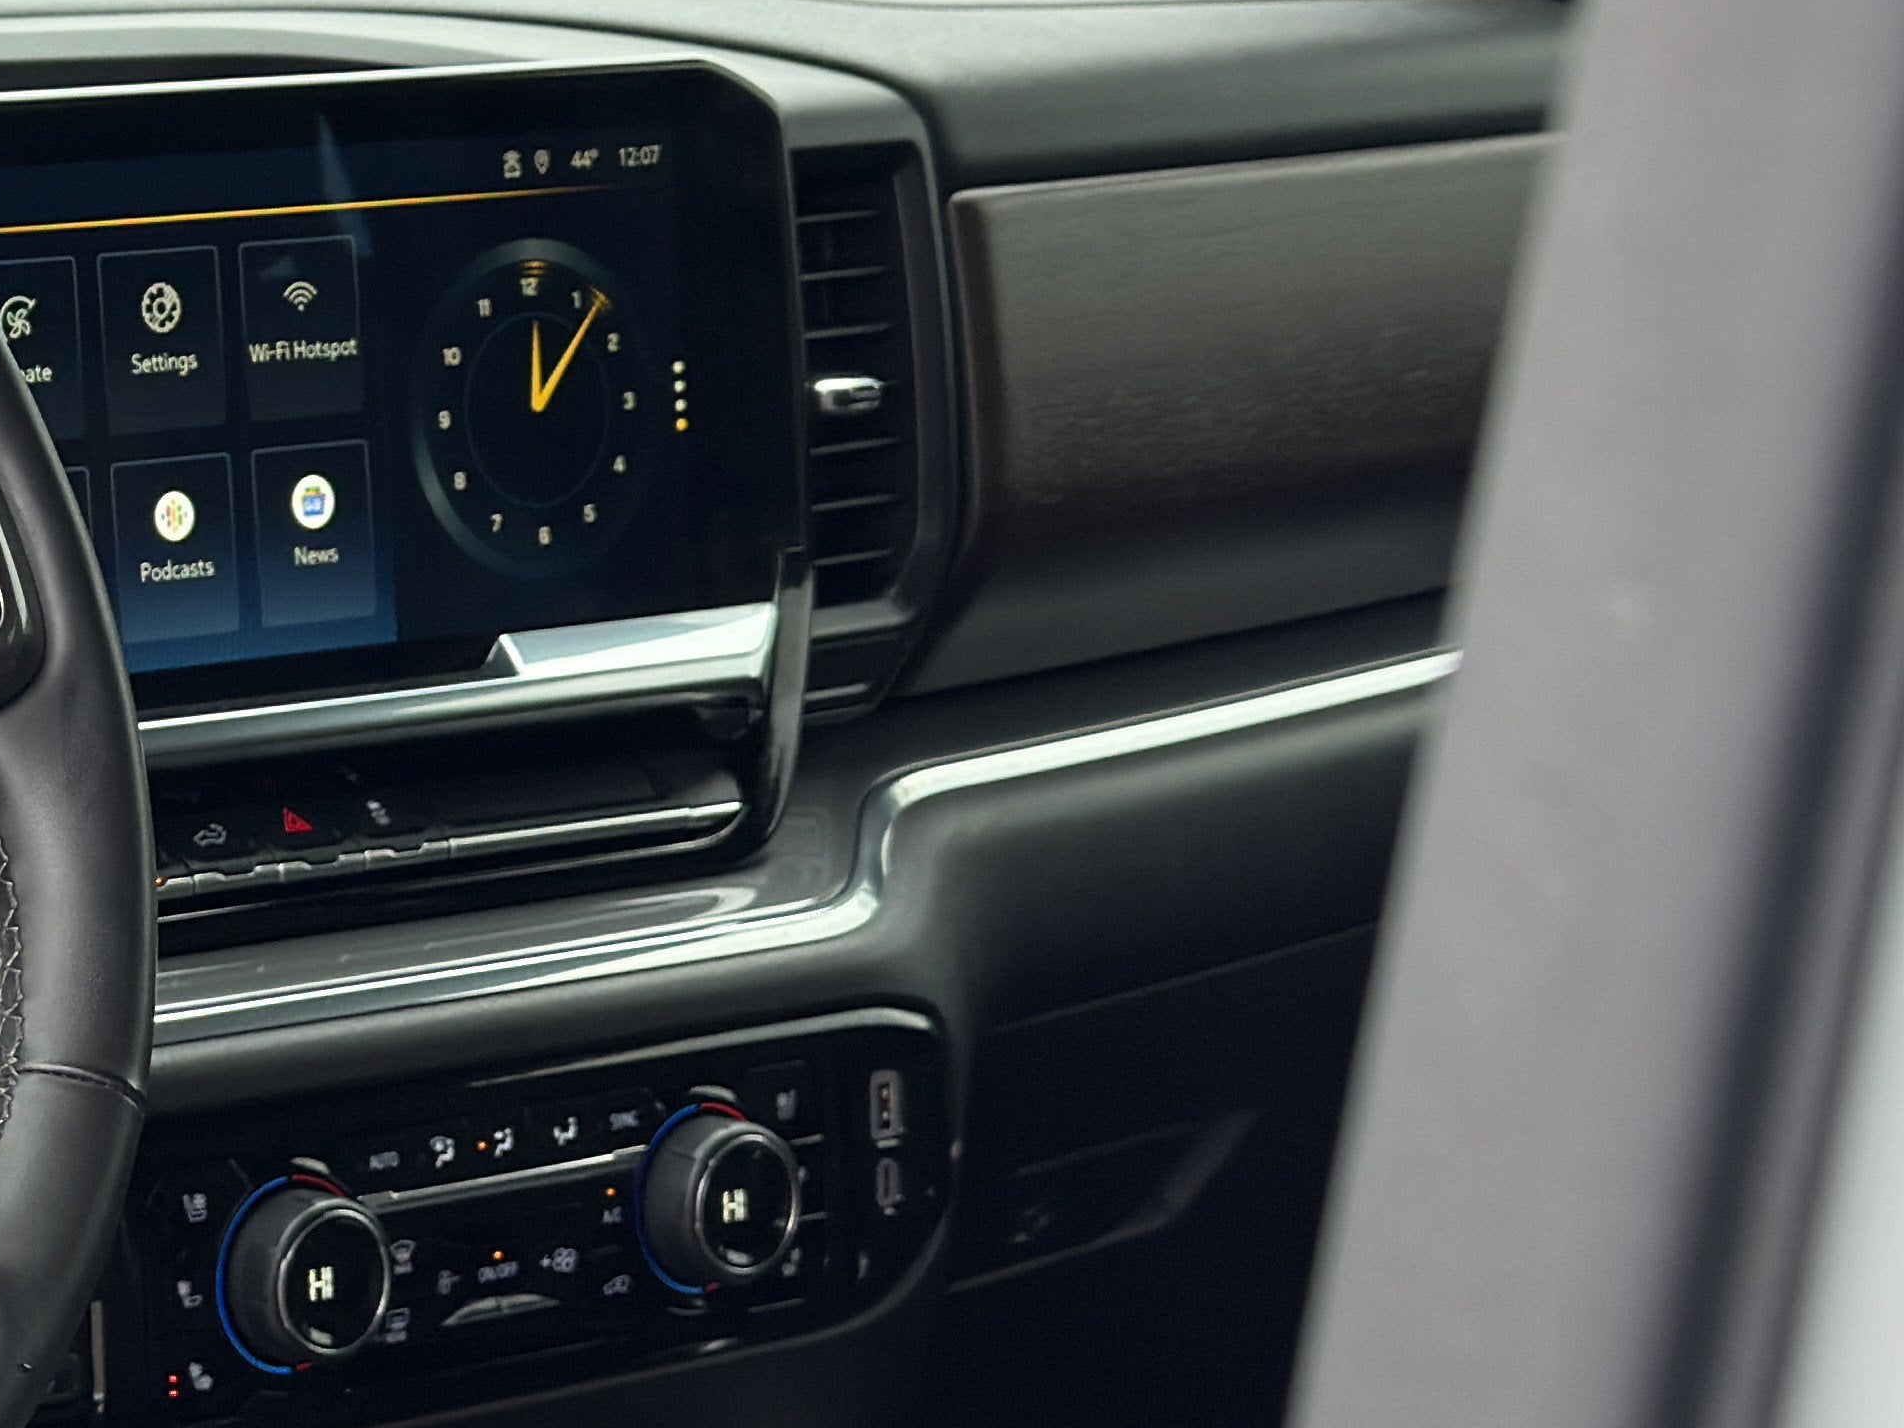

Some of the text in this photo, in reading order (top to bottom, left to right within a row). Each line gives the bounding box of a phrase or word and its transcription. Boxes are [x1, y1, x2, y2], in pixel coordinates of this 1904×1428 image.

[249, 338, 358, 363] Wi-Fi Hotspot
[131, 352, 198, 377] Settings
[294, 546, 339, 565] News
[141, 558, 215, 583] Podcasts
